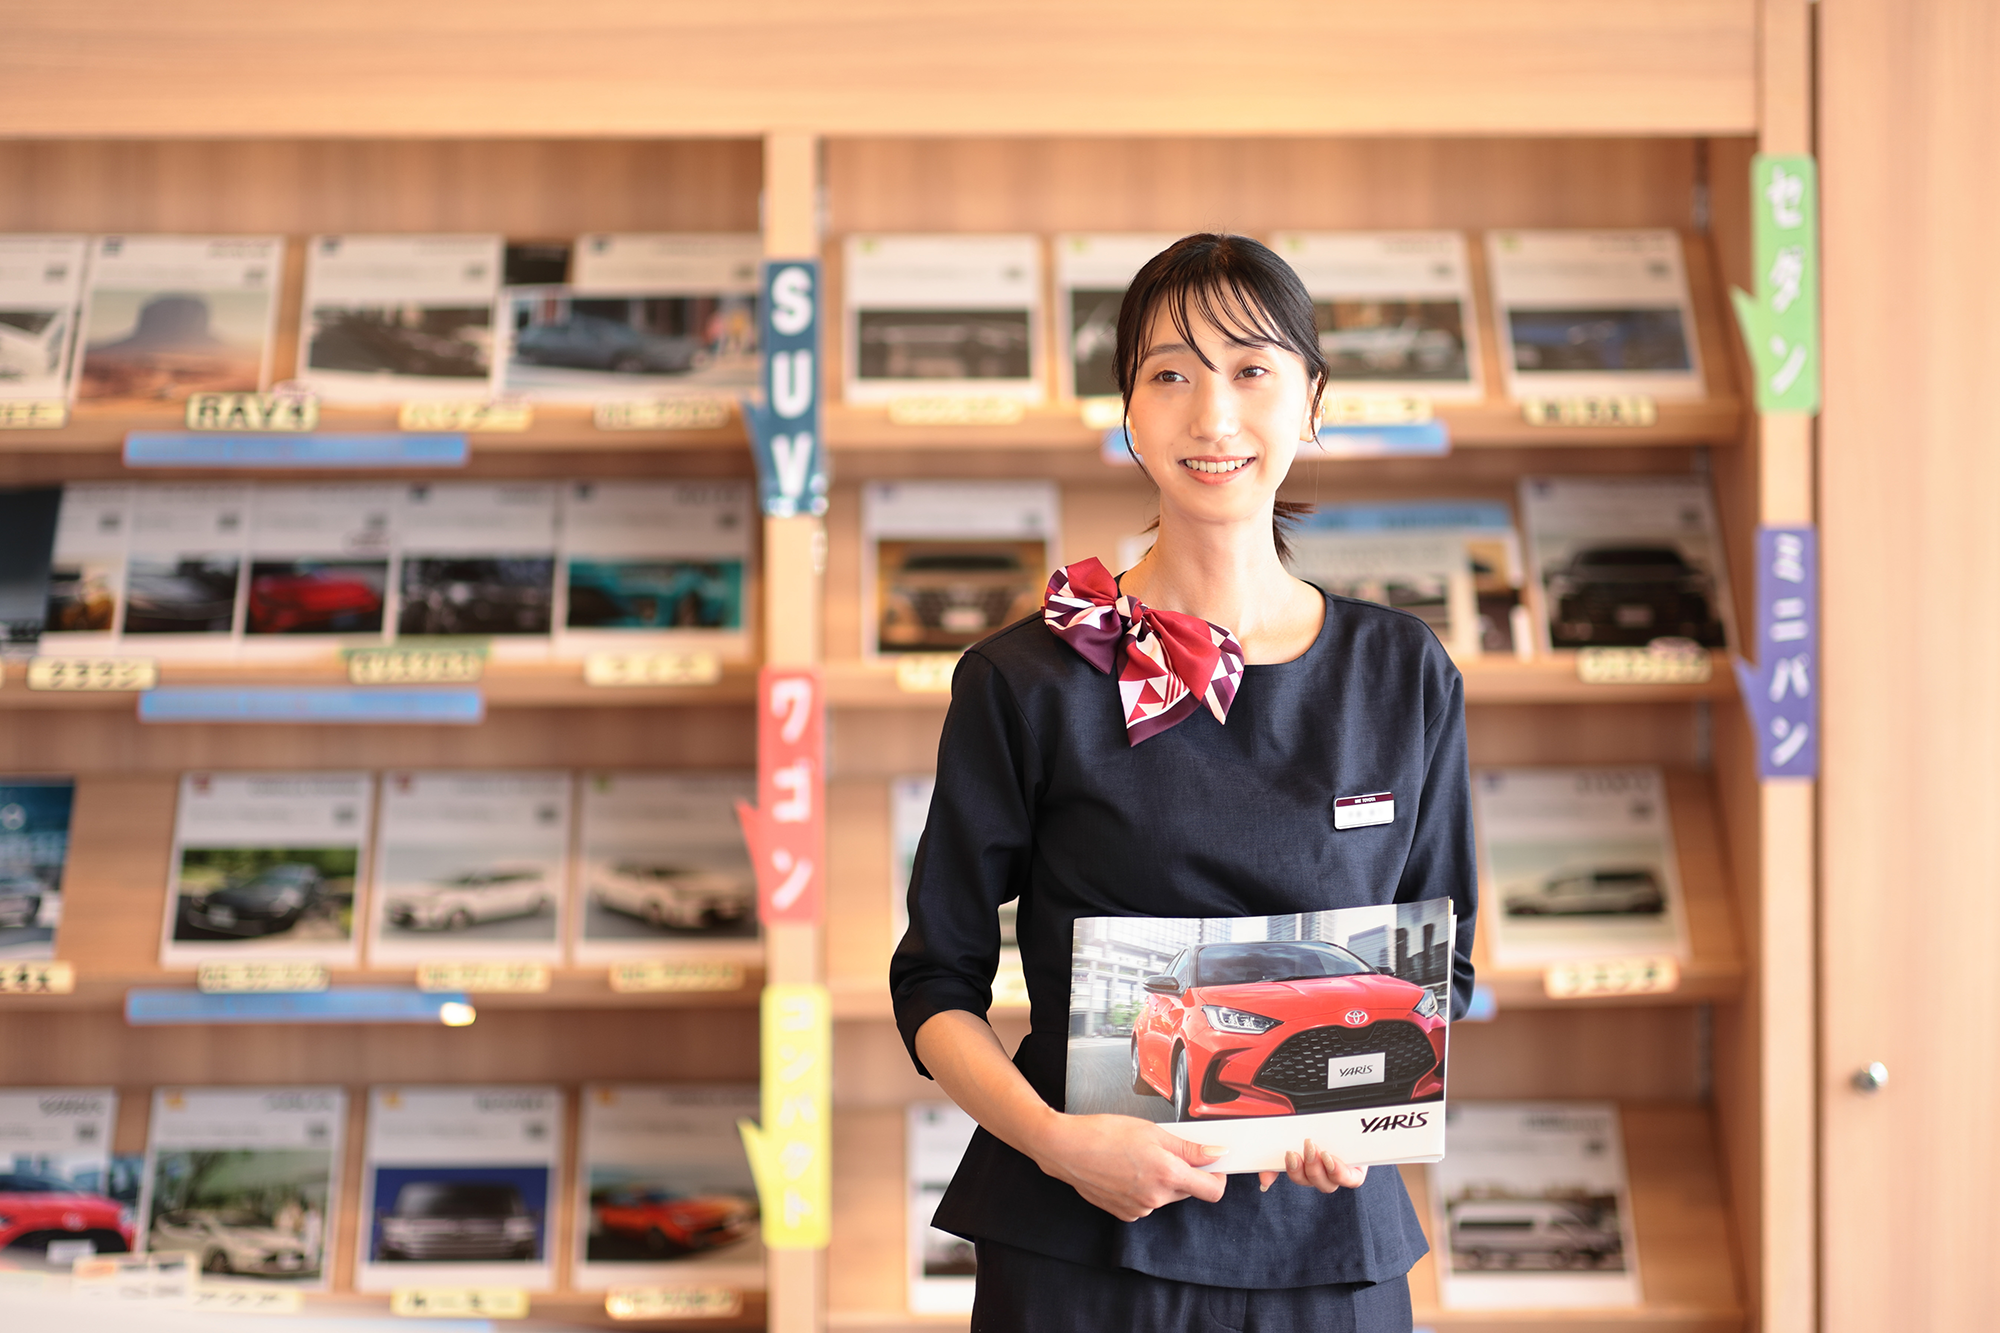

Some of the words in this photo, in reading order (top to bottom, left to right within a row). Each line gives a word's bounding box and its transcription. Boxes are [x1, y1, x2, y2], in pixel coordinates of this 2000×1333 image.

[771, 266, 814, 498] SUV
[1765, 164, 1807, 396] セダン
[198, 396, 307, 427] RAV4
[770, 677, 814, 911] ワゴン
